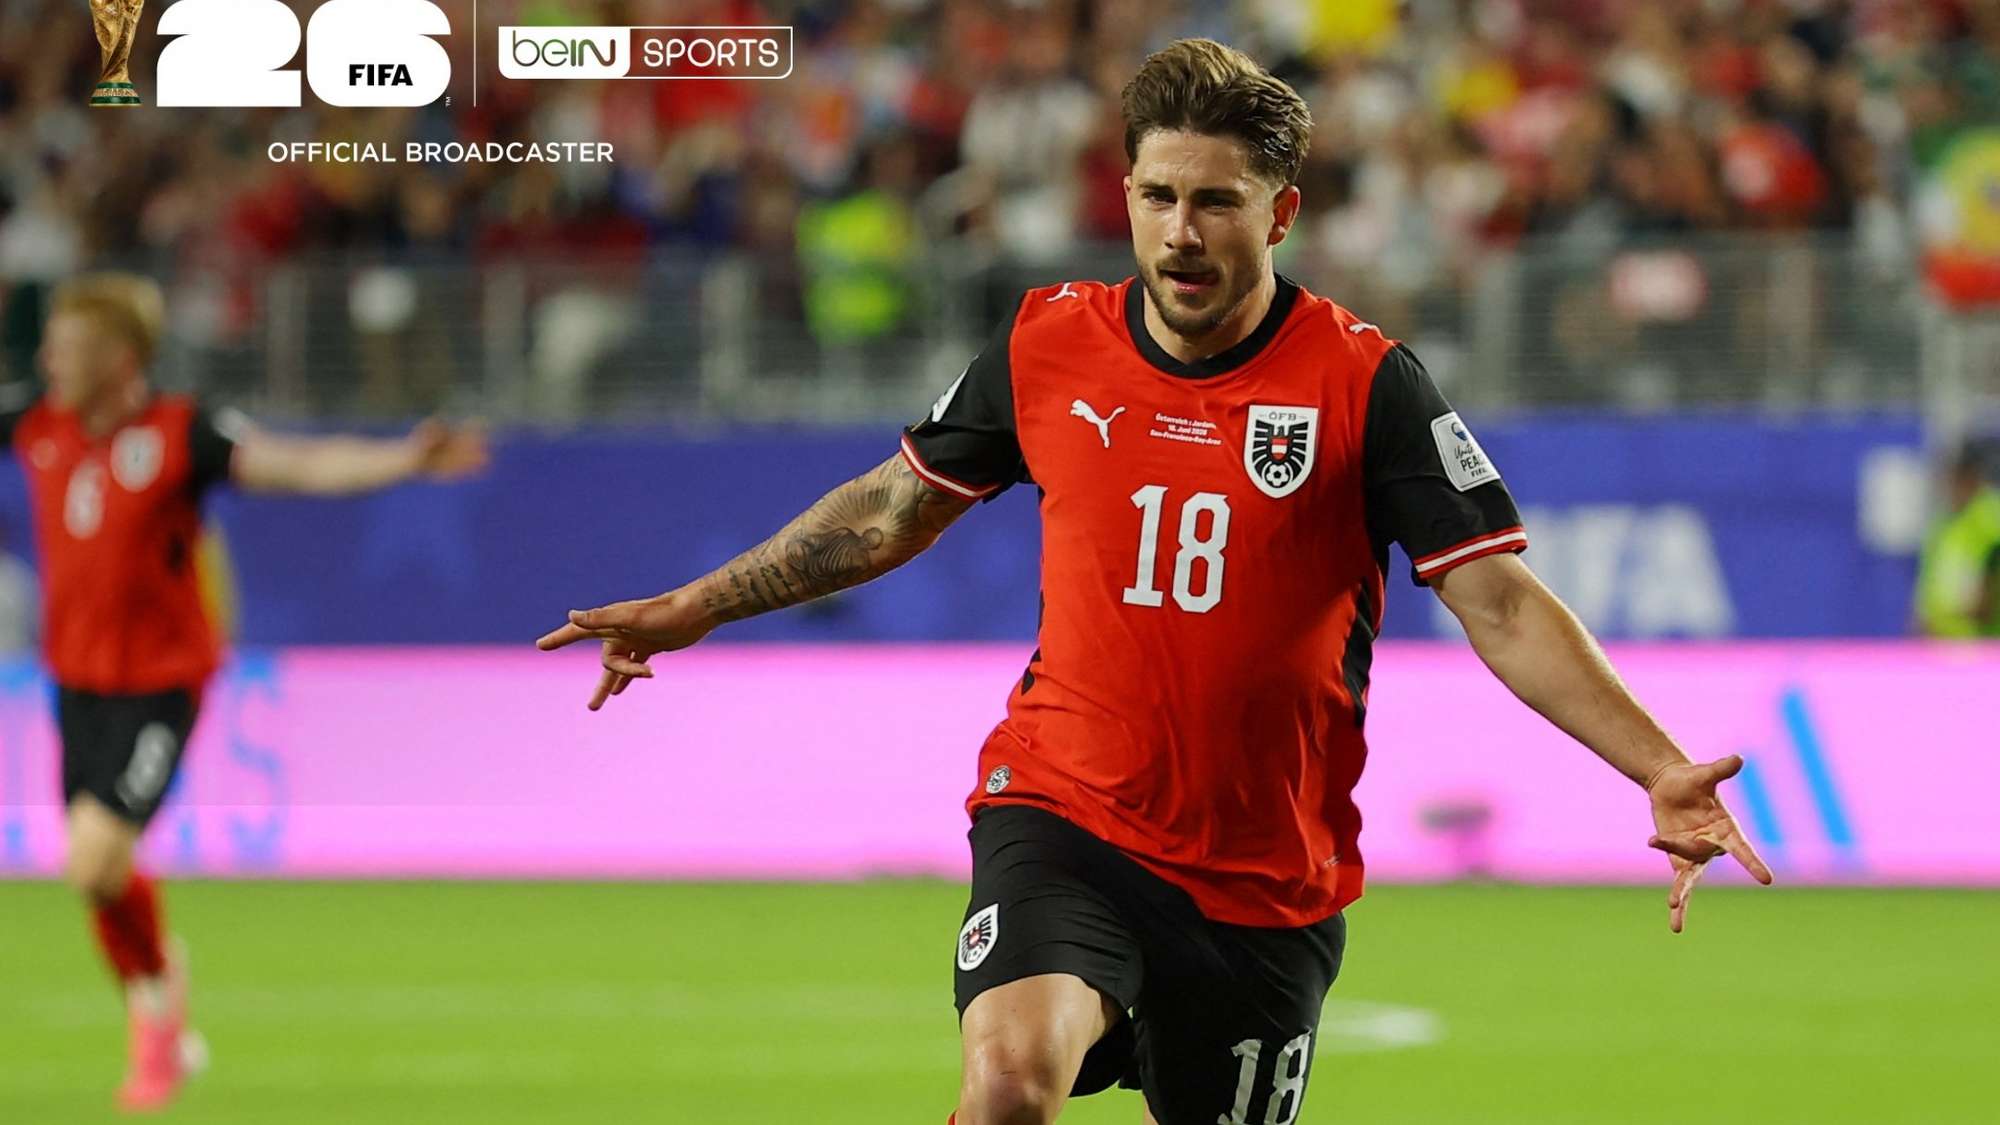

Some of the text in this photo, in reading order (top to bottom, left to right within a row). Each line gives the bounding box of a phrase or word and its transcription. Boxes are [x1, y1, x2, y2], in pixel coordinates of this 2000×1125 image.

[1122, 484, 1231, 613] 18
[1432, 502, 1740, 638] IFA
[1217, 1025, 1312, 1125] 18
